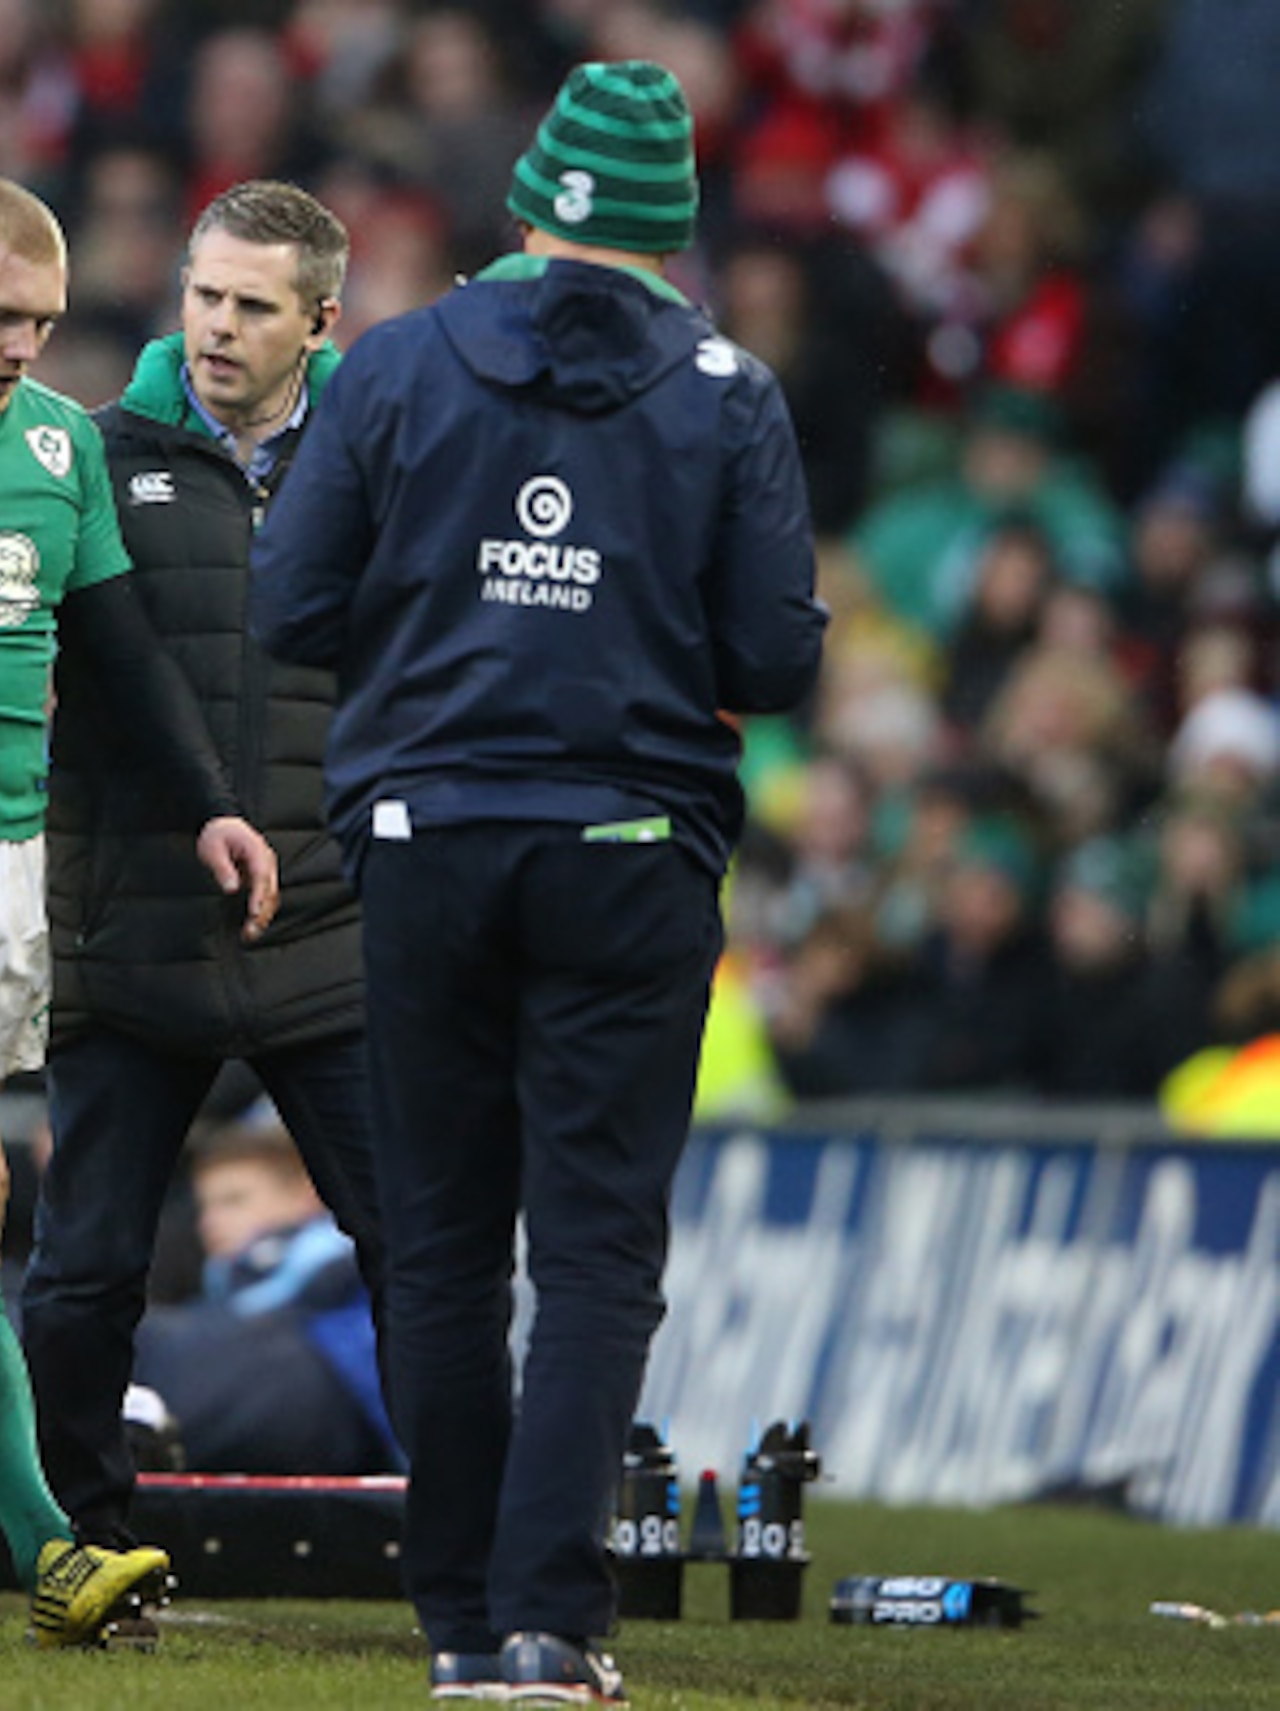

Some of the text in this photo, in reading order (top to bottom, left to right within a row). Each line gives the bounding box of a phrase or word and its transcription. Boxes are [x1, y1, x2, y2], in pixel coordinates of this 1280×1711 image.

[553, 169, 595, 224] 3
[478, 539, 602, 585] FOCUS
[872, 1601, 943, 1624] PRO
